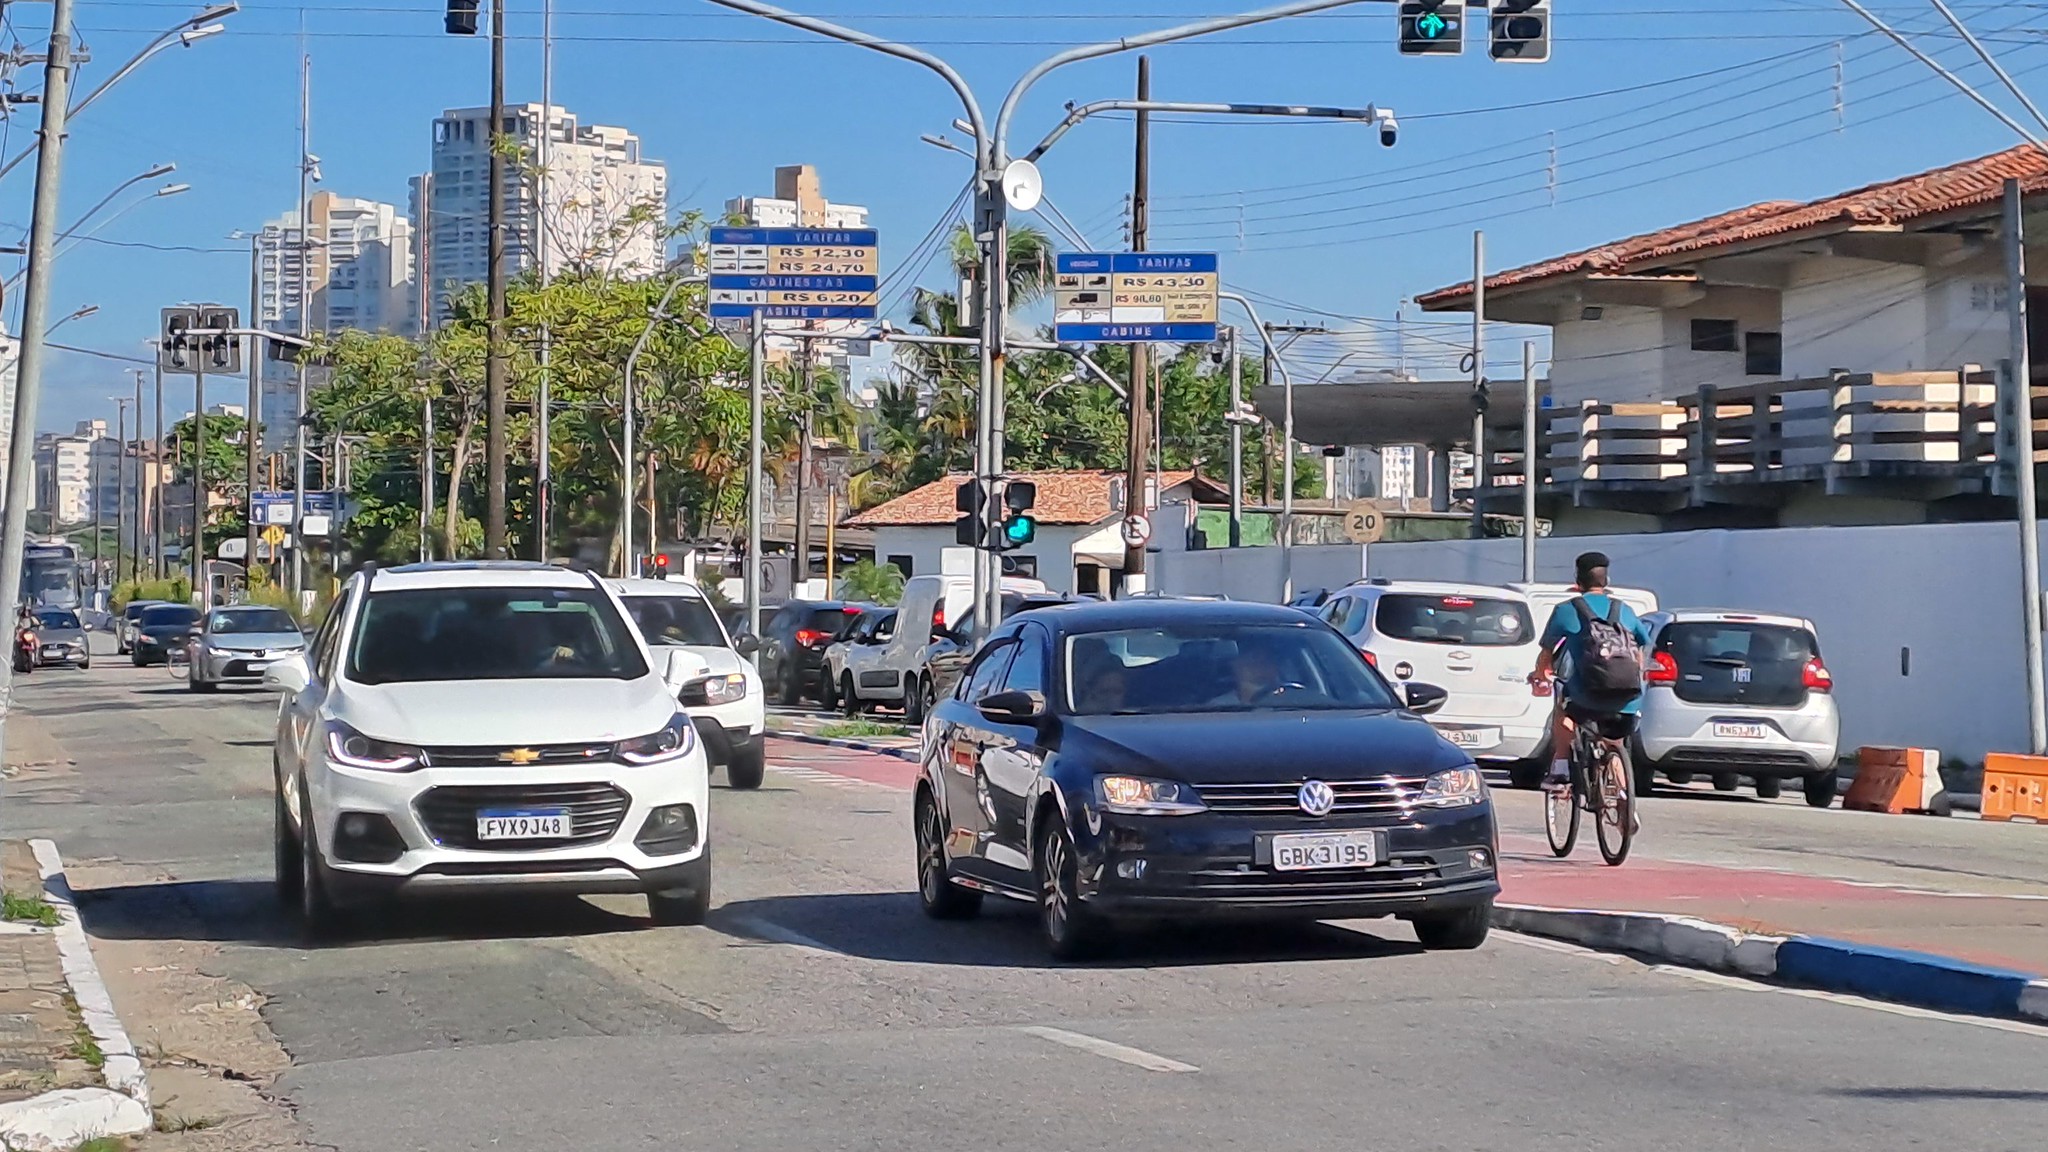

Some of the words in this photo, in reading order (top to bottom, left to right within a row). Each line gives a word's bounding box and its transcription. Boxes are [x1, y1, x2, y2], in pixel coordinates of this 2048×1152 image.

[795, 233, 850, 243] TARIFAS
[812, 248, 865, 258] 12,30
[811, 262, 864, 273] 24,70
[1138, 258, 1192, 268] TARIFAS
[749, 278, 811, 288] CABINES
[816, 292, 860, 303] 6,20
[757, 307, 808, 316] ABINE
[1101, 327, 1152, 337] CABINE
[1353, 514, 1376, 530] 20
[487, 818, 561, 836] FYX9J48
